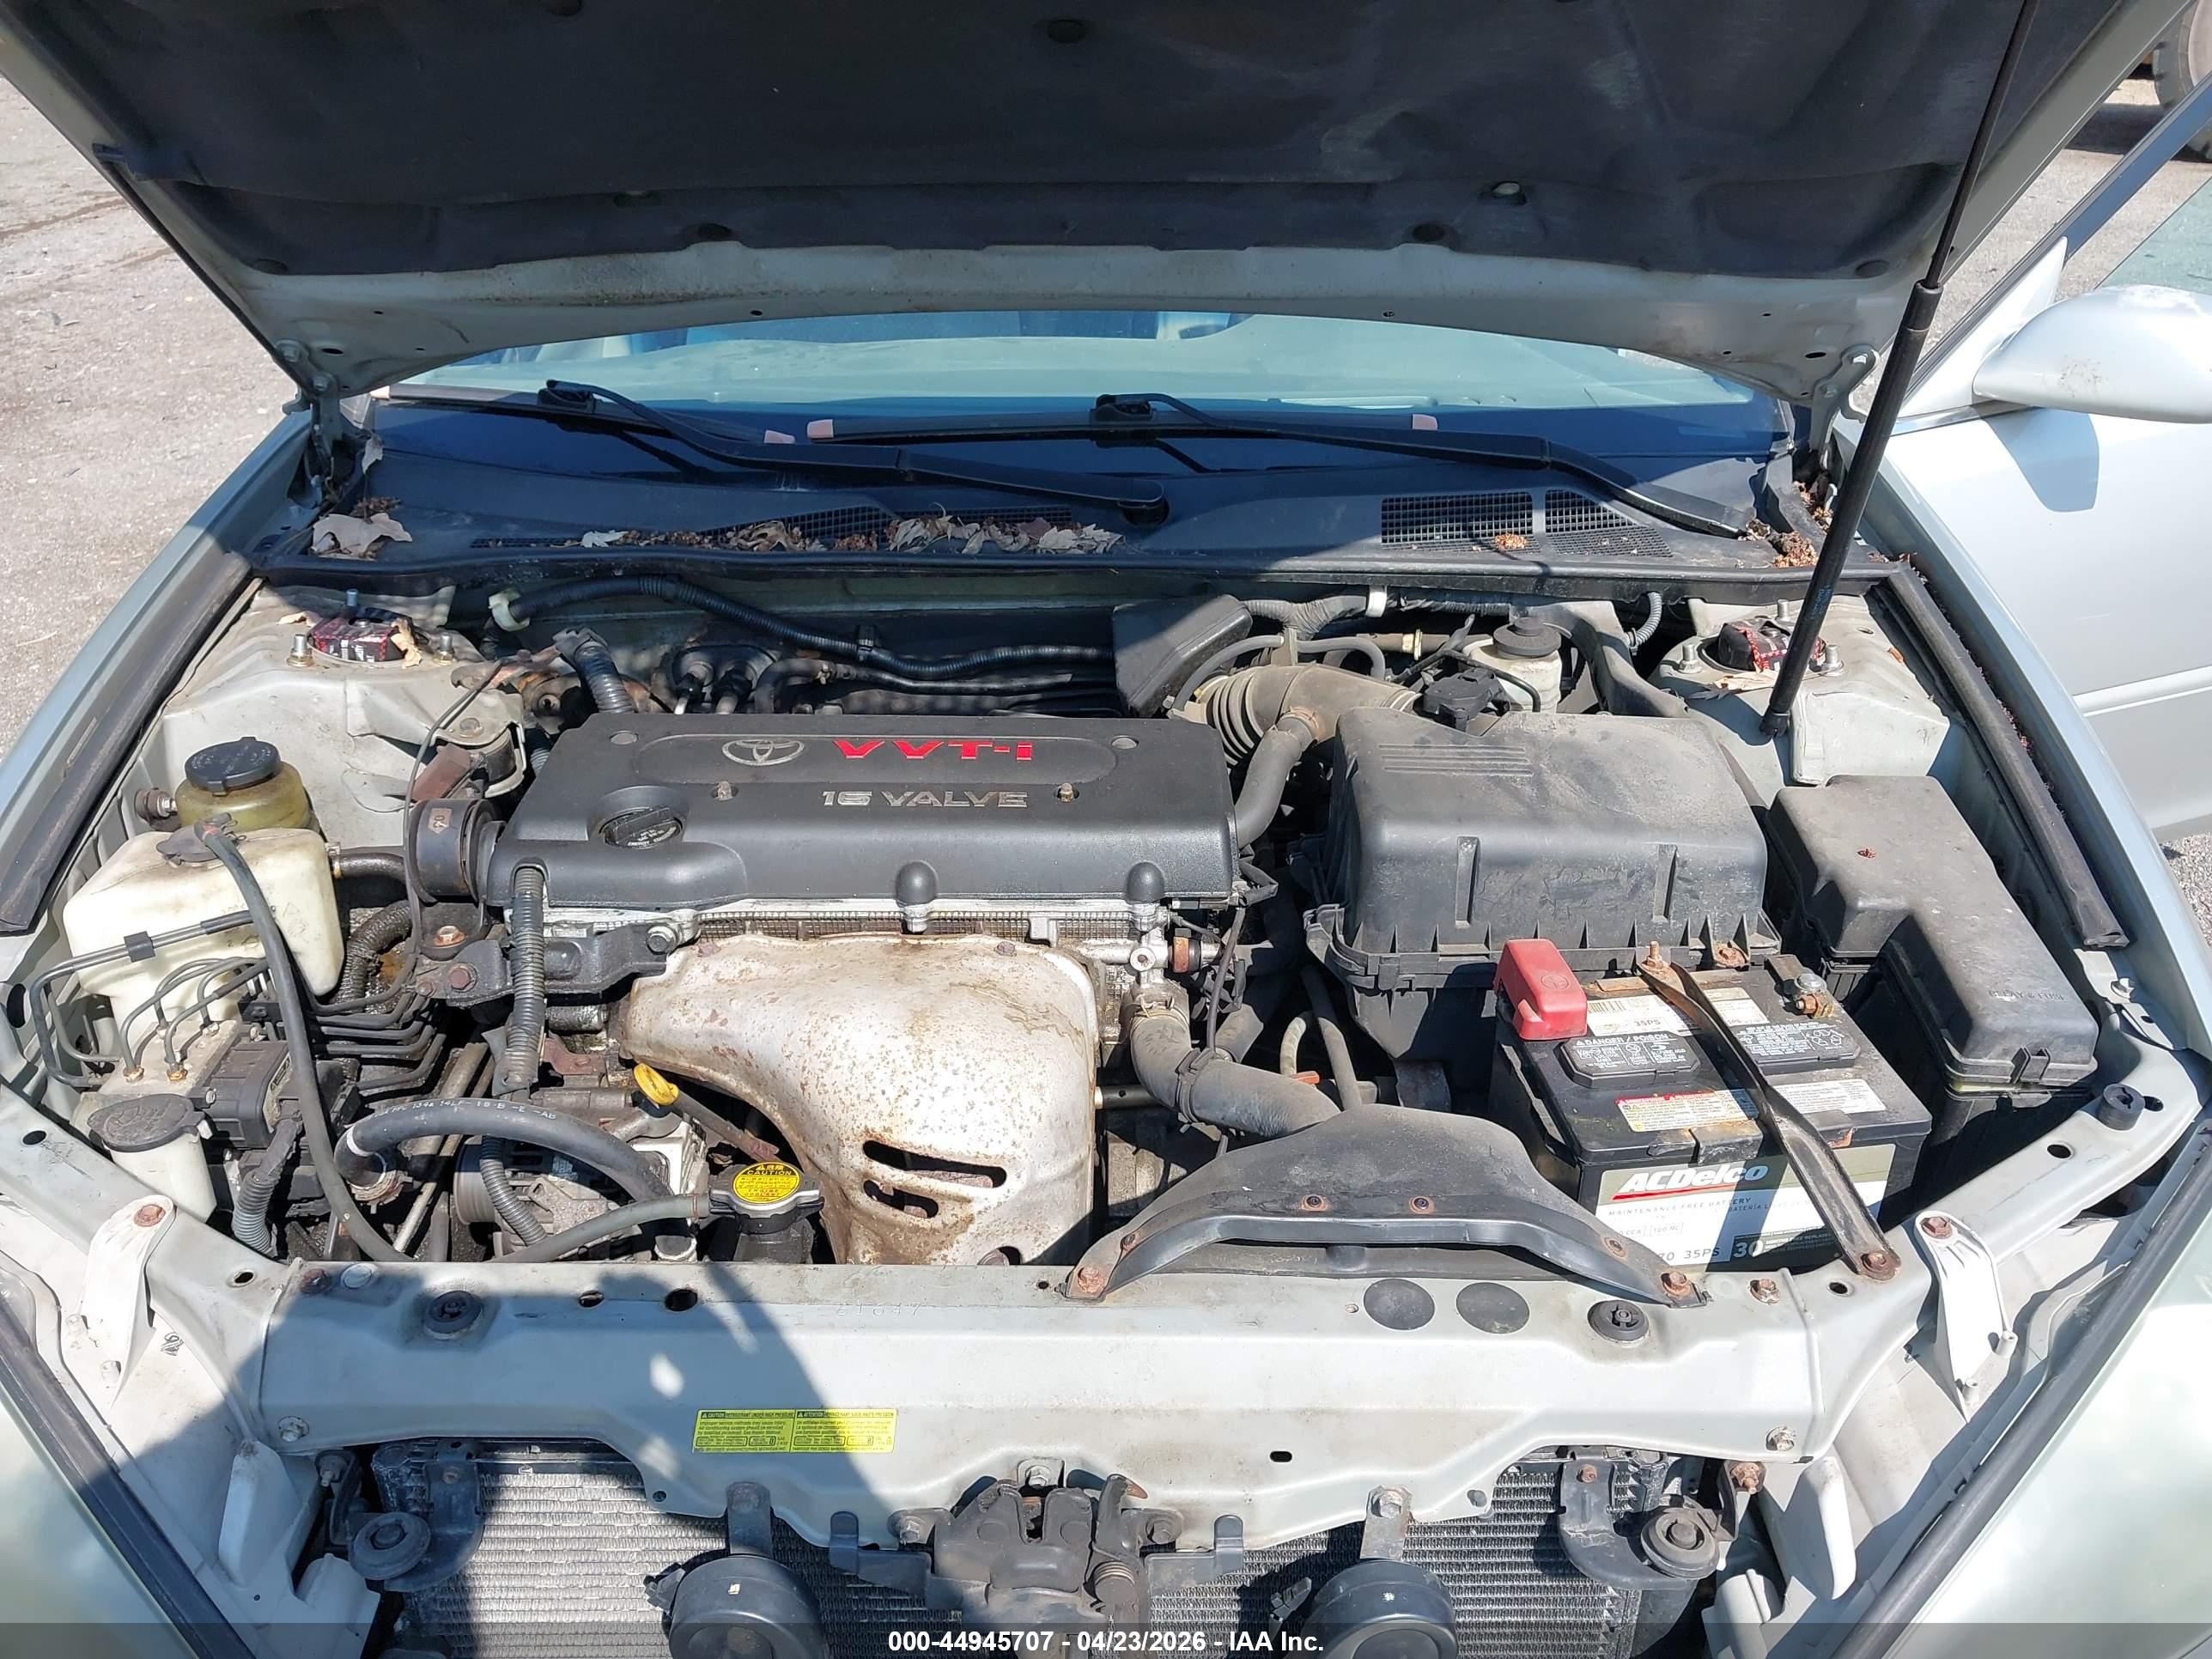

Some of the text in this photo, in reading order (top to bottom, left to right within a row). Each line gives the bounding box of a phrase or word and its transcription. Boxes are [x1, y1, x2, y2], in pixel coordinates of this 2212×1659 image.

[822, 790, 1029, 808] 16 VALVE
[1584, 1036, 1625, 1046] DANGER
[1633, 1033, 1669, 1042] POISON
[1618, 1164, 1769, 1194] ACDelco
[1709, 1196, 1753, 1209] BATTERY
[1684, 1248, 1720, 1259] 35PS
[1733, 1239, 1764, 1258] 30
